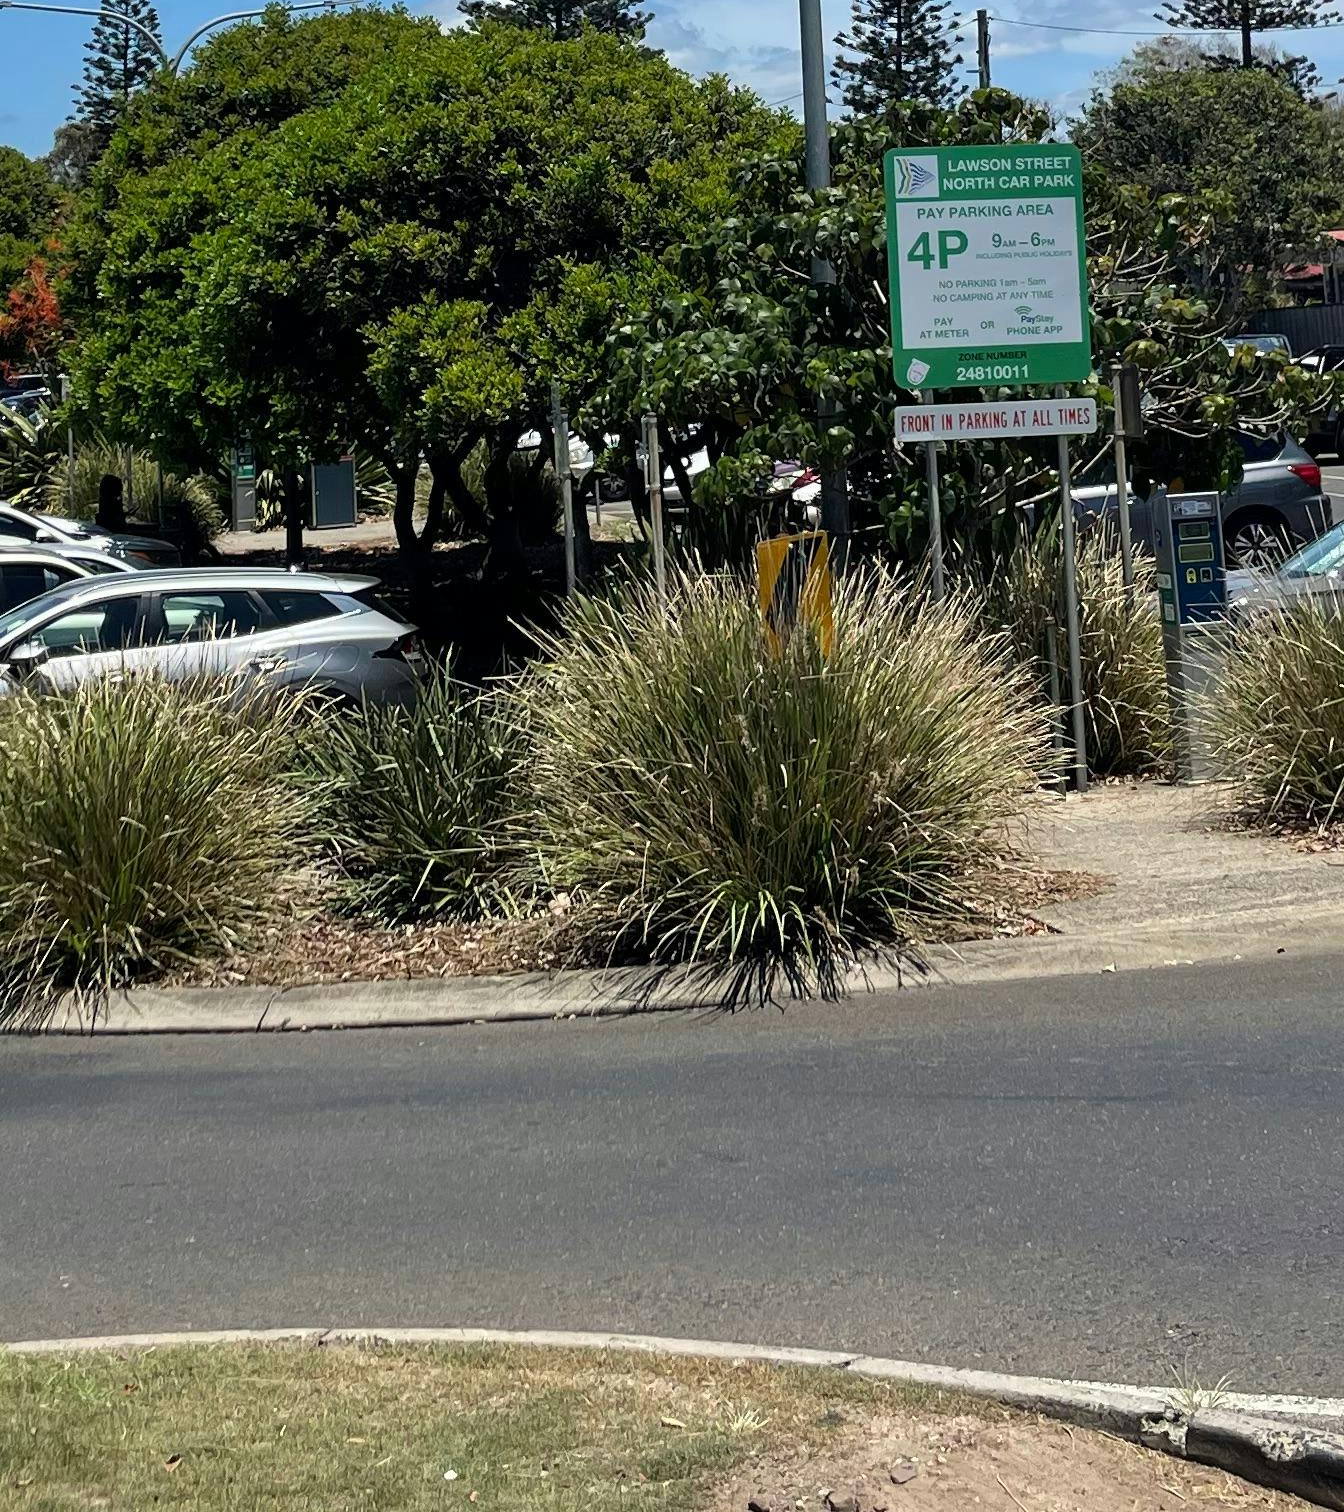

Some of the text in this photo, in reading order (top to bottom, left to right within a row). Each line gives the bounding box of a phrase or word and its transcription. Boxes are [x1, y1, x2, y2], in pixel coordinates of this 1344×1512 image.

[948, 156, 1072, 173] LAWSON STREET
[943, 174, 1075, 191] NORTH CAR PARK
[917, 203, 1054, 219] PAY PARKING AREA
[991, 233, 1017, 248] 9AM
[1031, 232, 1055, 247] 6PM
[907, 229, 969, 270] 4P
[976, 249, 1072, 260] INCLUDING PUBLIC HOLIDAYS
[939, 280, 954, 289] NO
[956, 279, 997, 288] PARKING
[999, 278, 1018, 287] 1am
[933, 290, 1054, 303] NO CAMPING AT ANY TIME
[934, 317, 954, 327] PAY
[980, 320, 995, 329] OR
[919, 329, 969, 339] AT METER
[1007, 325, 1063, 336] PHONE APP
[958, 351, 1028, 361] ZONE NUMBER
[956, 365, 1029, 381] 24810011
[901, 407, 1090, 432] FRONT IN PARKING AT ALL TIMES
